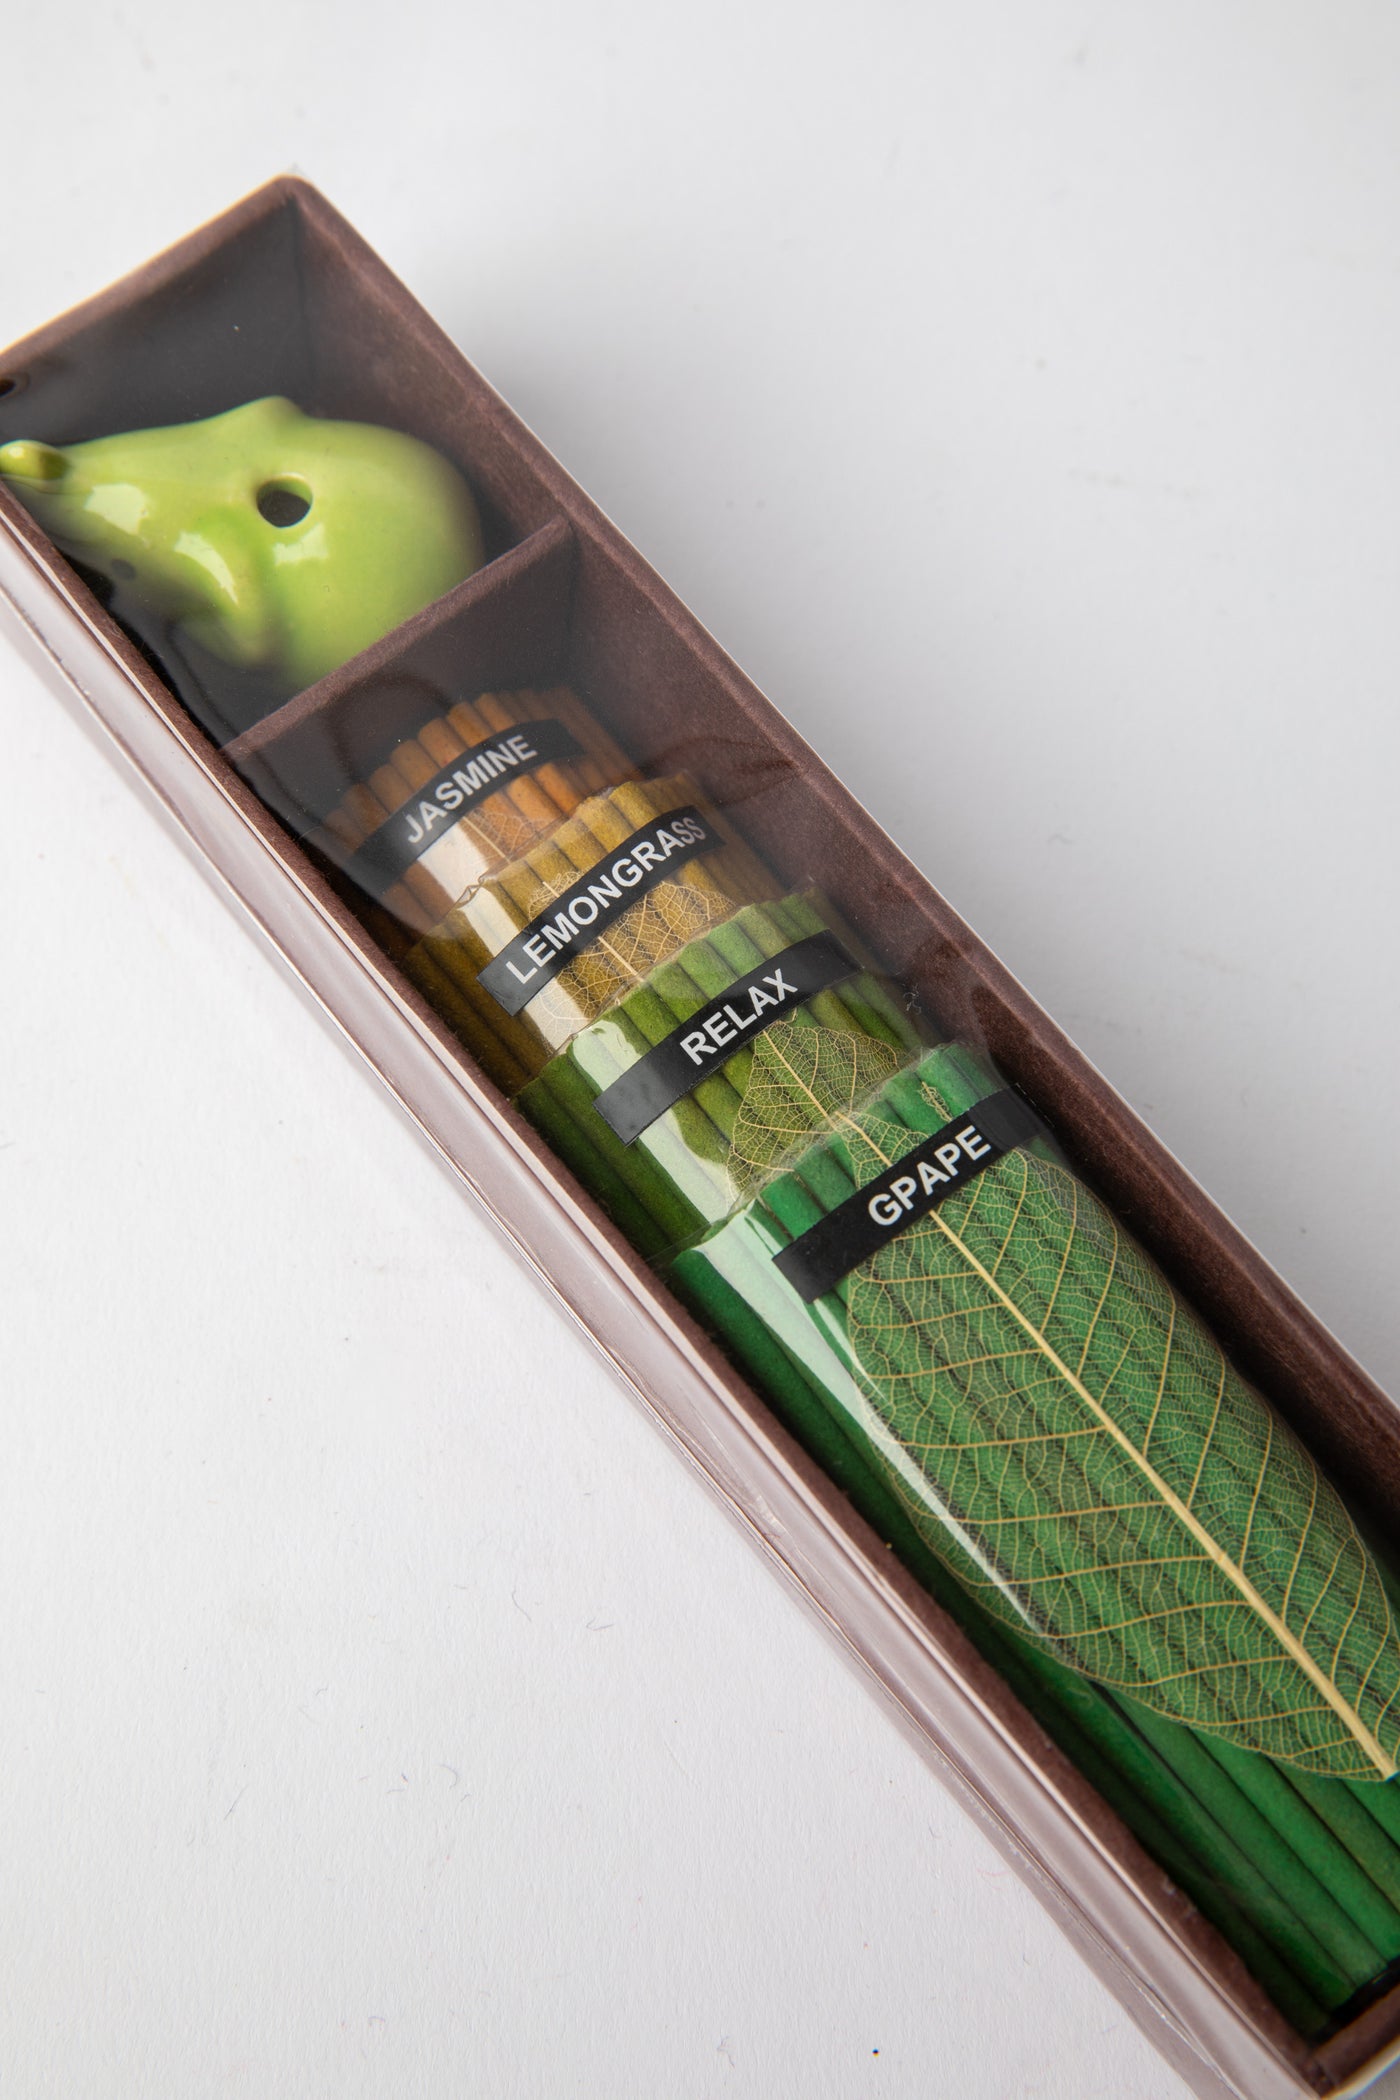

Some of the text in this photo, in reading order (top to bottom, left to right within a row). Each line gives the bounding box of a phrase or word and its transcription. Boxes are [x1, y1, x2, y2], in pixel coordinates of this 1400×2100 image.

[402, 734, 538, 843] JASMINE
[505, 816, 706, 985] LEMONGRASS
[679, 968, 798, 1066] RELAX
[868, 1125, 992, 1226] GPAPE
